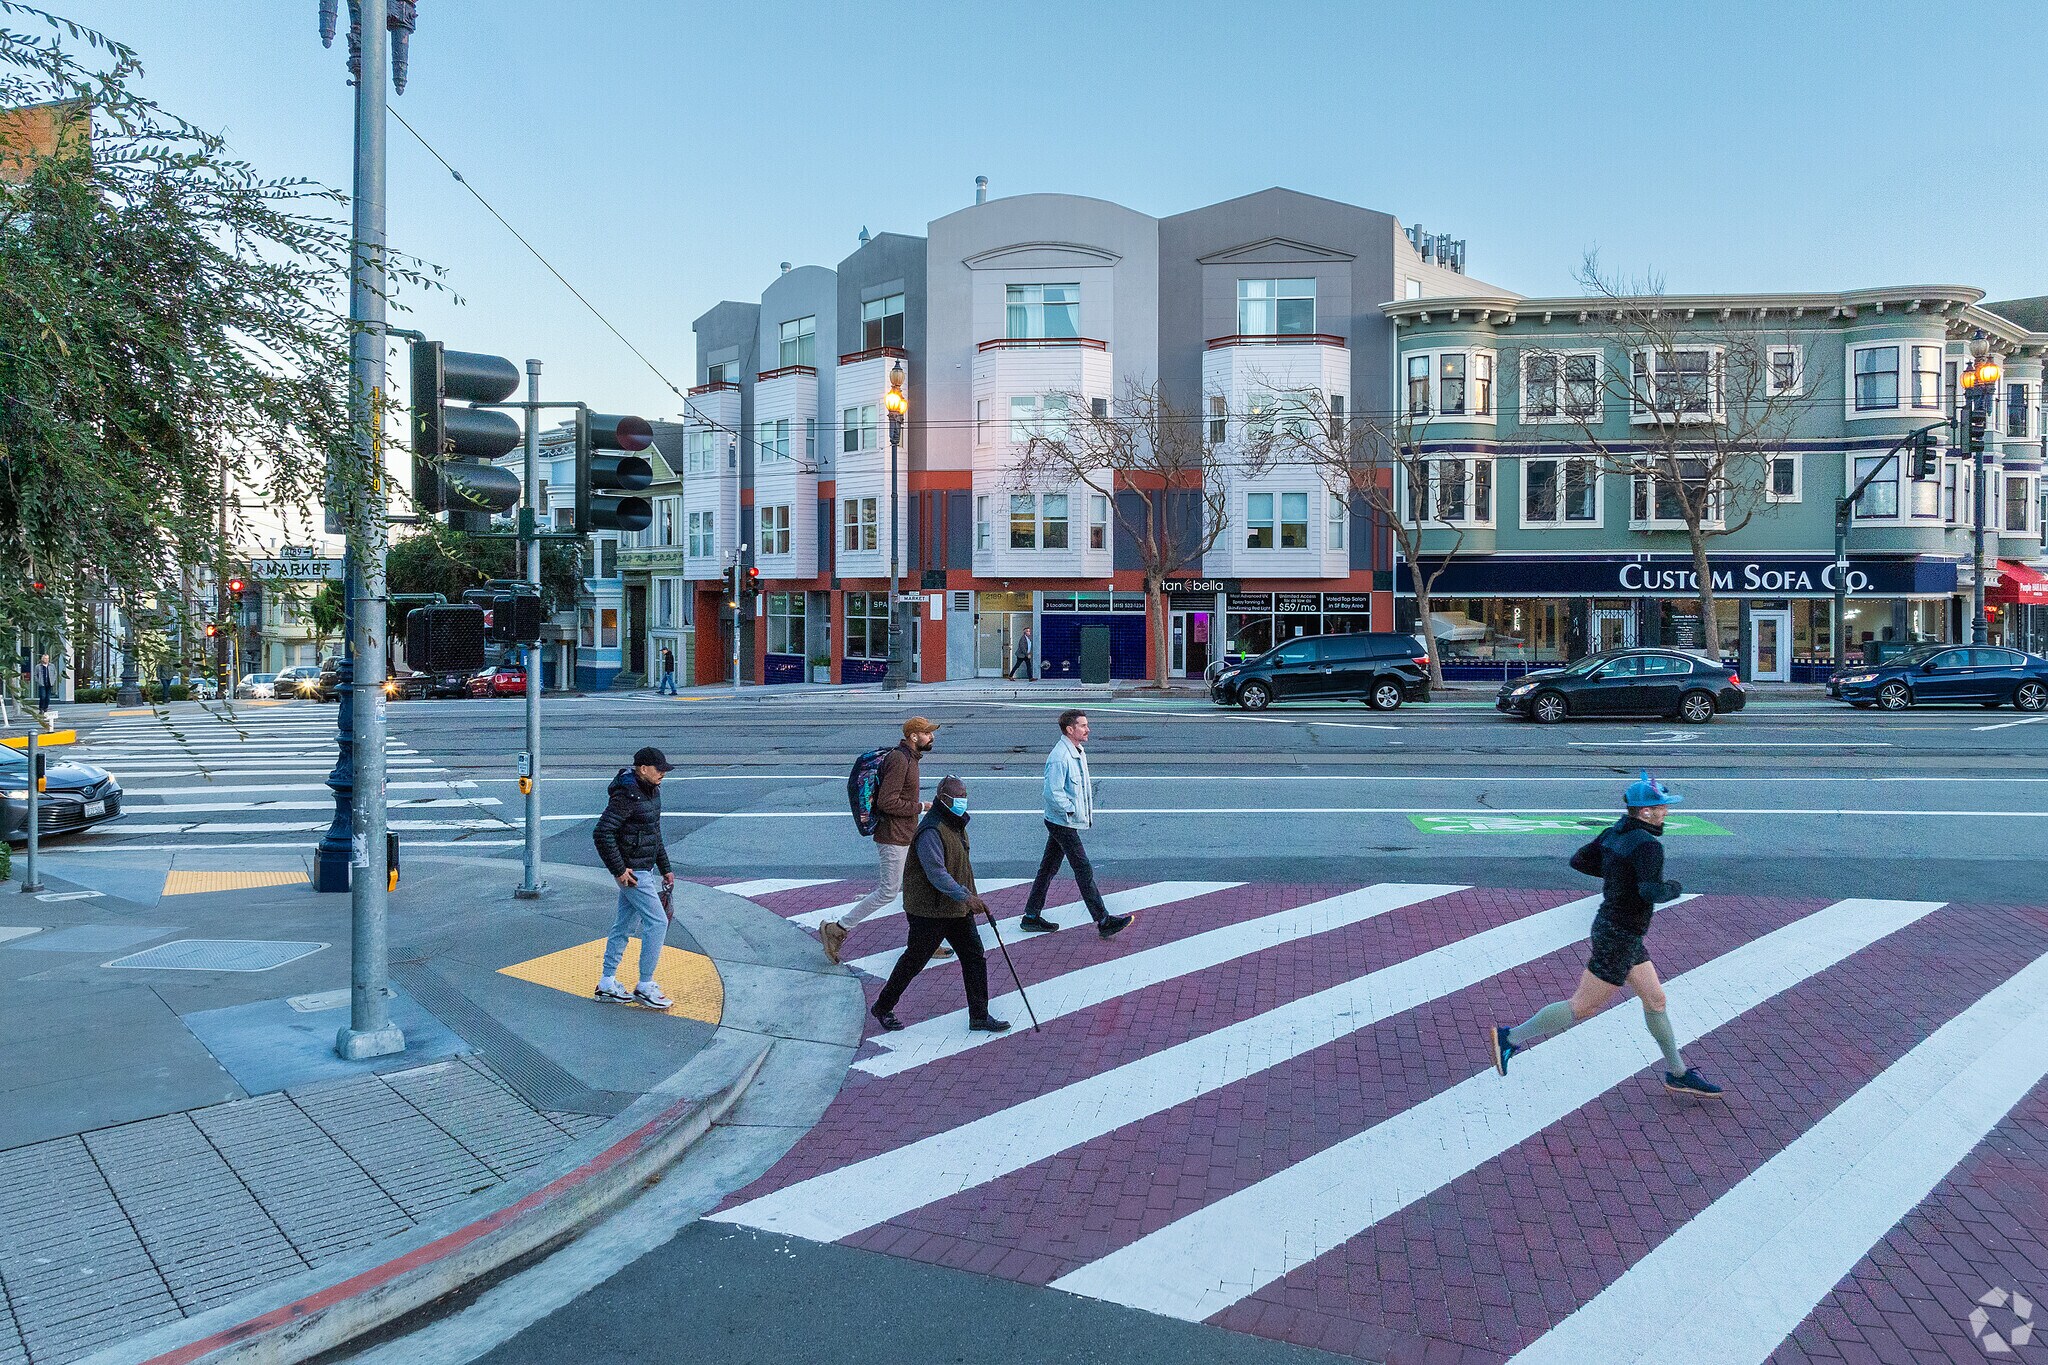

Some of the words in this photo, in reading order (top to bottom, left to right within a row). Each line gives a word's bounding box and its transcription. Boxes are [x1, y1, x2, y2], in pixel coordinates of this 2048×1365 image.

[266, 563, 330, 576] MARKET
[1744, 564, 1812, 590] SOFA
[1821, 564, 1874, 590] CO.
[1161, 580, 1182, 591] tan
[1193, 580, 1224, 591] bella
[1278, 602, 1317, 612] $59/mo
